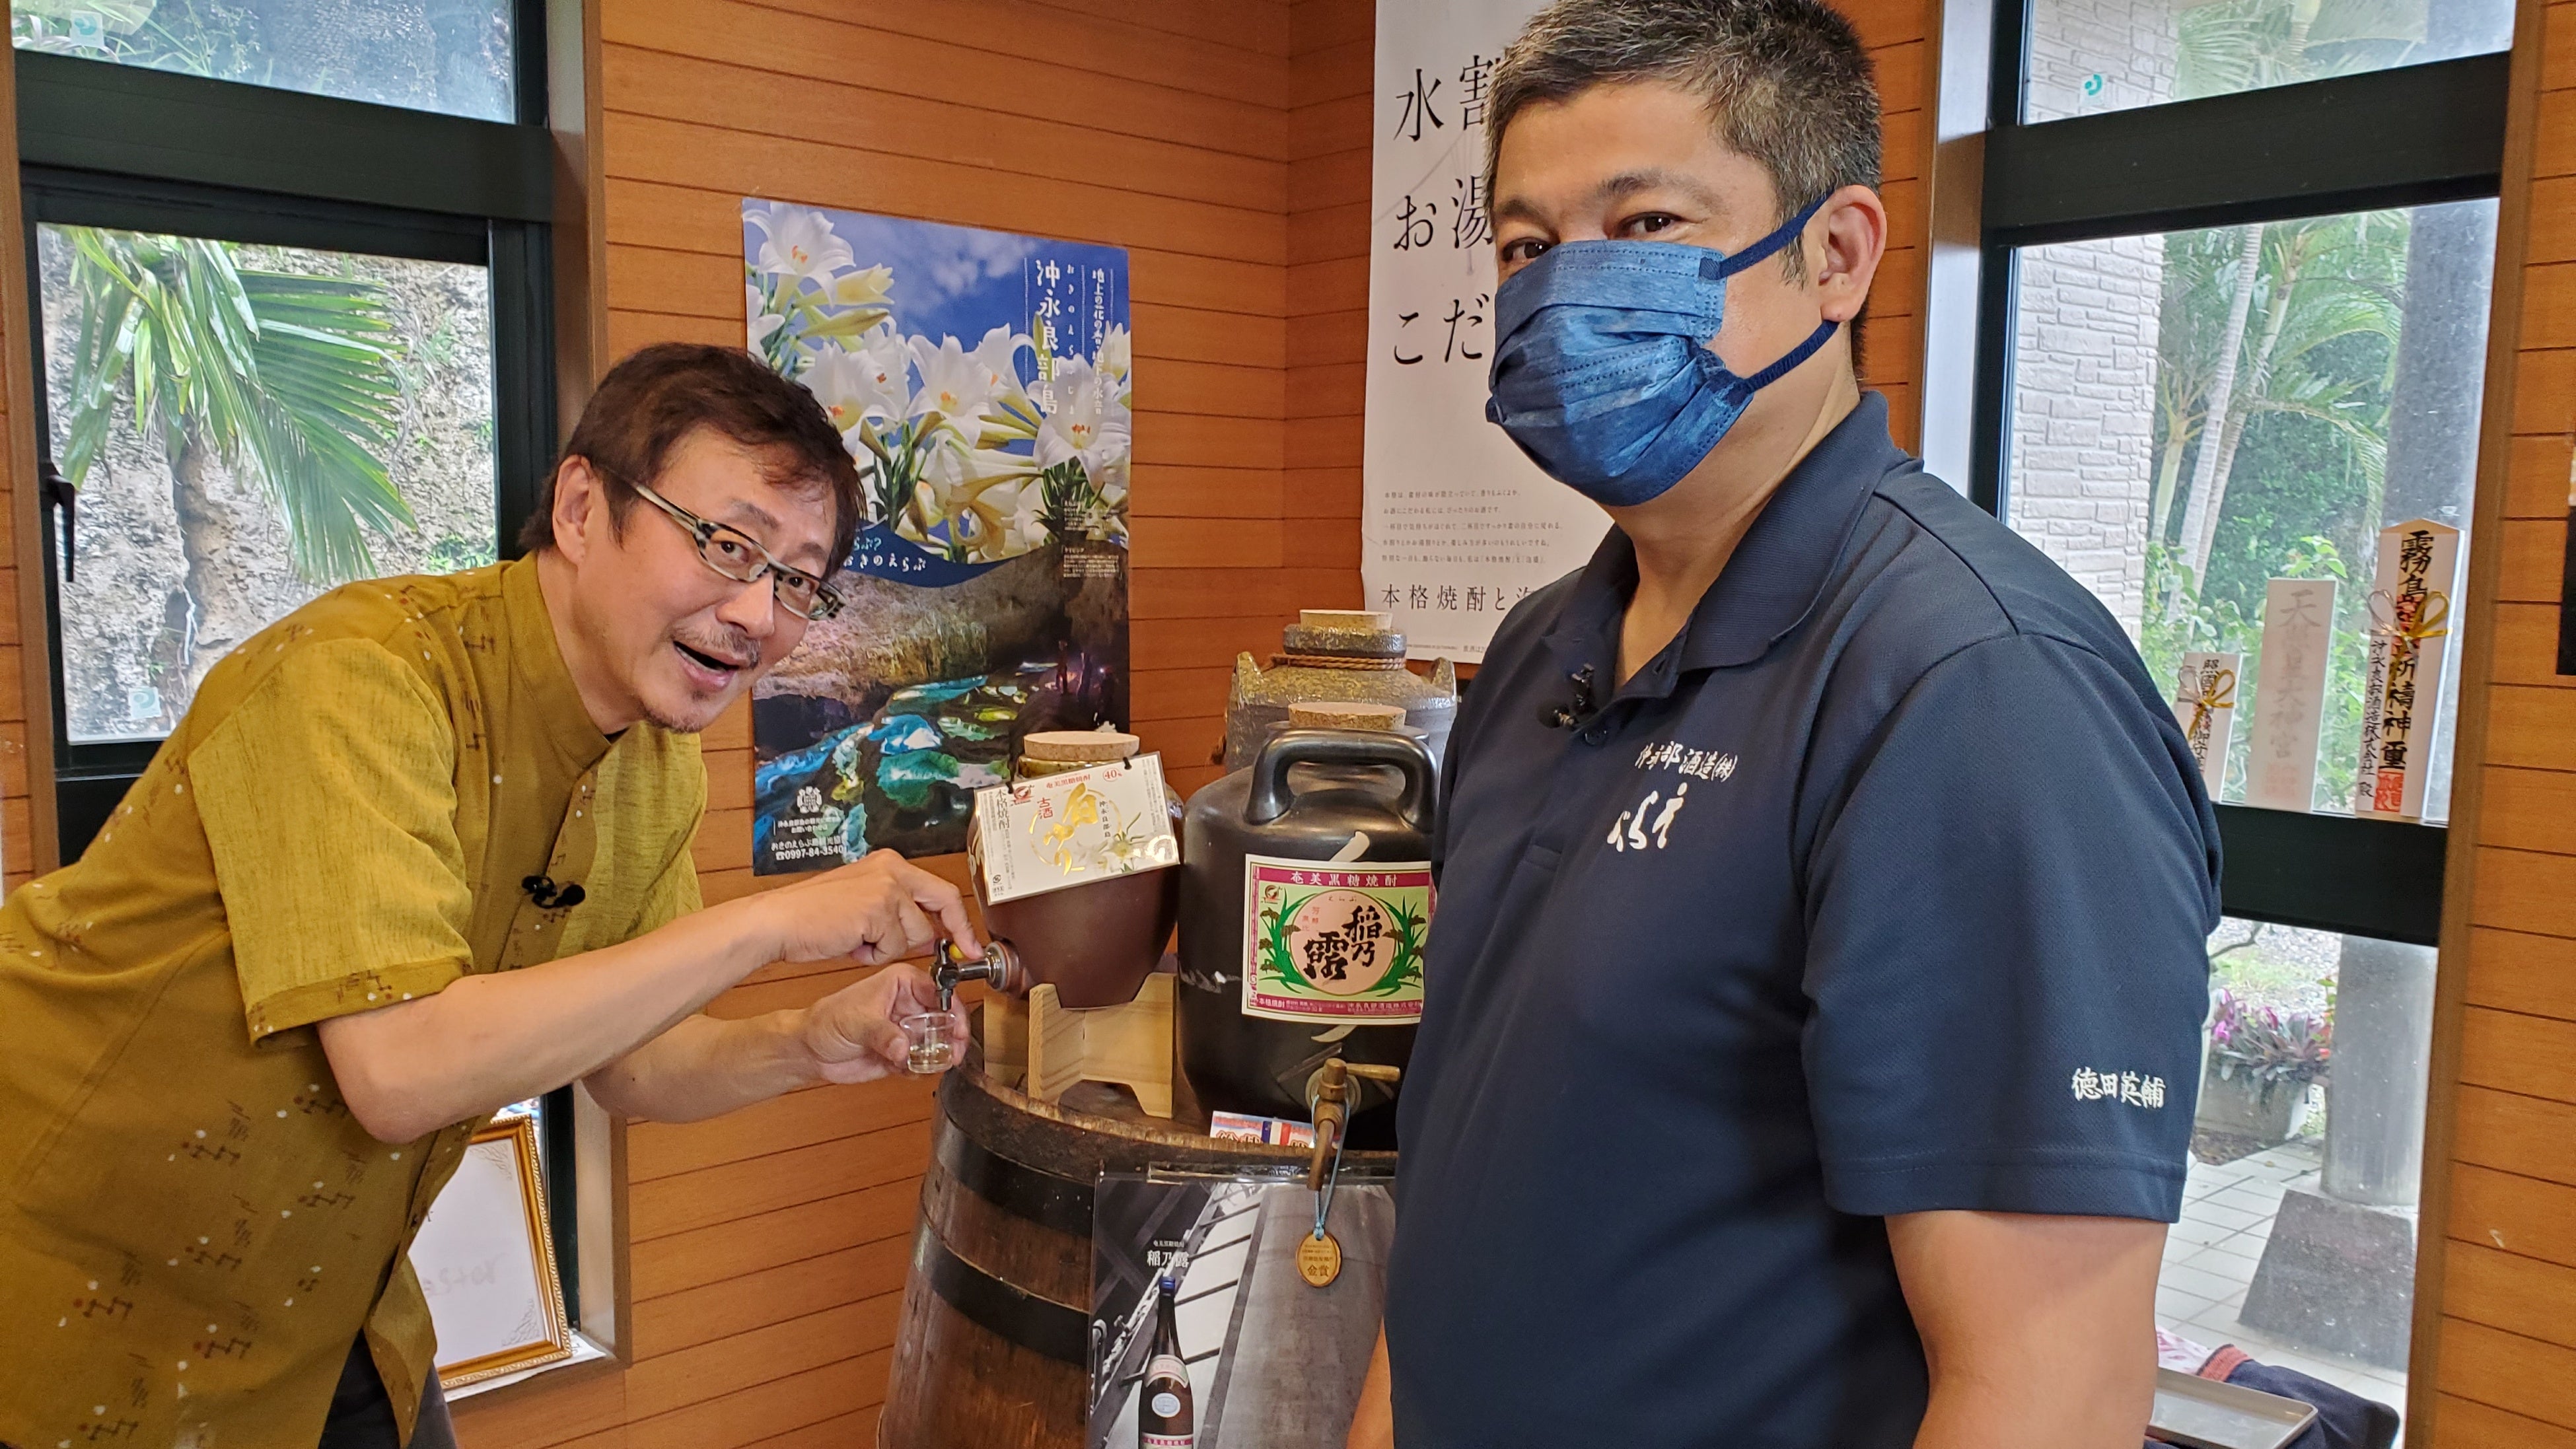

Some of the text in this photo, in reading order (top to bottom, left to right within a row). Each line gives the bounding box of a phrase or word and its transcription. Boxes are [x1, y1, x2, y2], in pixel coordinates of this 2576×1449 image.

[1035, 259, 1061, 415] 沖永良部島
[1394, 293, 1489, 365] こだ
[843, 553, 926, 572] おきのえらぶ
[1037, 796, 1054, 820] 古酒
[1291, 871, 1398, 888] 奄美黒糖焼酎
[1147, 1250, 1190, 1268] 稲乃露
